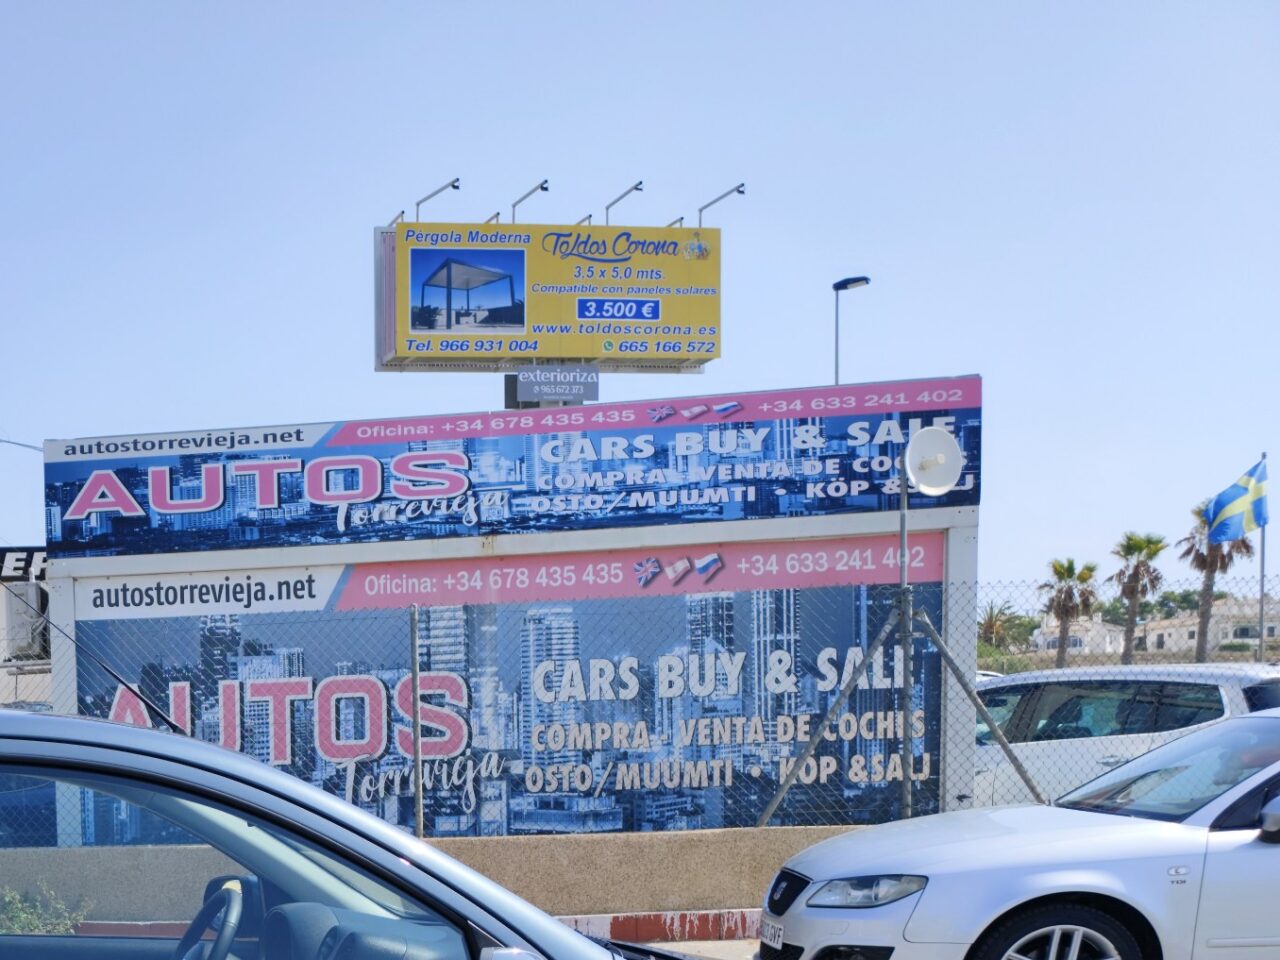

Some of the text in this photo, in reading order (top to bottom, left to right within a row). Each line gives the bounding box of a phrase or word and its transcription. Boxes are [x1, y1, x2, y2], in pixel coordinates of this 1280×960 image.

[467, 230, 532, 244] Moderna
[612, 232, 680, 257] Corona
[599, 268, 607, 279] x
[636, 269, 666, 280] mts.
[531, 283, 718, 297] Compatible con paneles solares
[584, 302, 655, 317] 3.500 €
[532, 323, 718, 336] www.toldoscorona.es
[406, 339, 539, 352] Tel. 966 931 004
[618, 341, 717, 354] 665 166 572
[519, 368, 598, 383] exterioriza
[758, 389, 963, 413] +34 633 241 402
[356, 410, 636, 439] Oficina: +34 678 435 435
[64, 428, 305, 456] autostorrevieja.net
[541, 434, 656, 463] CARS
[675, 427, 771, 456] BUY
[792, 425, 827, 449] &
[63, 450, 471, 520] AUTOS
[538, 467, 666, 490] COMPRA
[698, 459, 793, 482] VENTA
[803, 457, 841, 475] DE
[806, 477, 870, 498] KÖP
[336, 490, 511, 532] Torrevieja
[737, 553, 780, 576] +34
[786, 551, 828, 574] 633
[835, 548, 876, 571] 241
[92, 573, 317, 609] autostorrevieja.net
[364, 563, 624, 595] Oficina: +34 678 435 435
[534, 656, 640, 702] CARS
[658, 652, 746, 698] BUY
[765, 649, 798, 694] &
[531, 721, 651, 751] COMPRA
[679, 715, 765, 746] VENTA
[777, 714, 811, 743] DE
